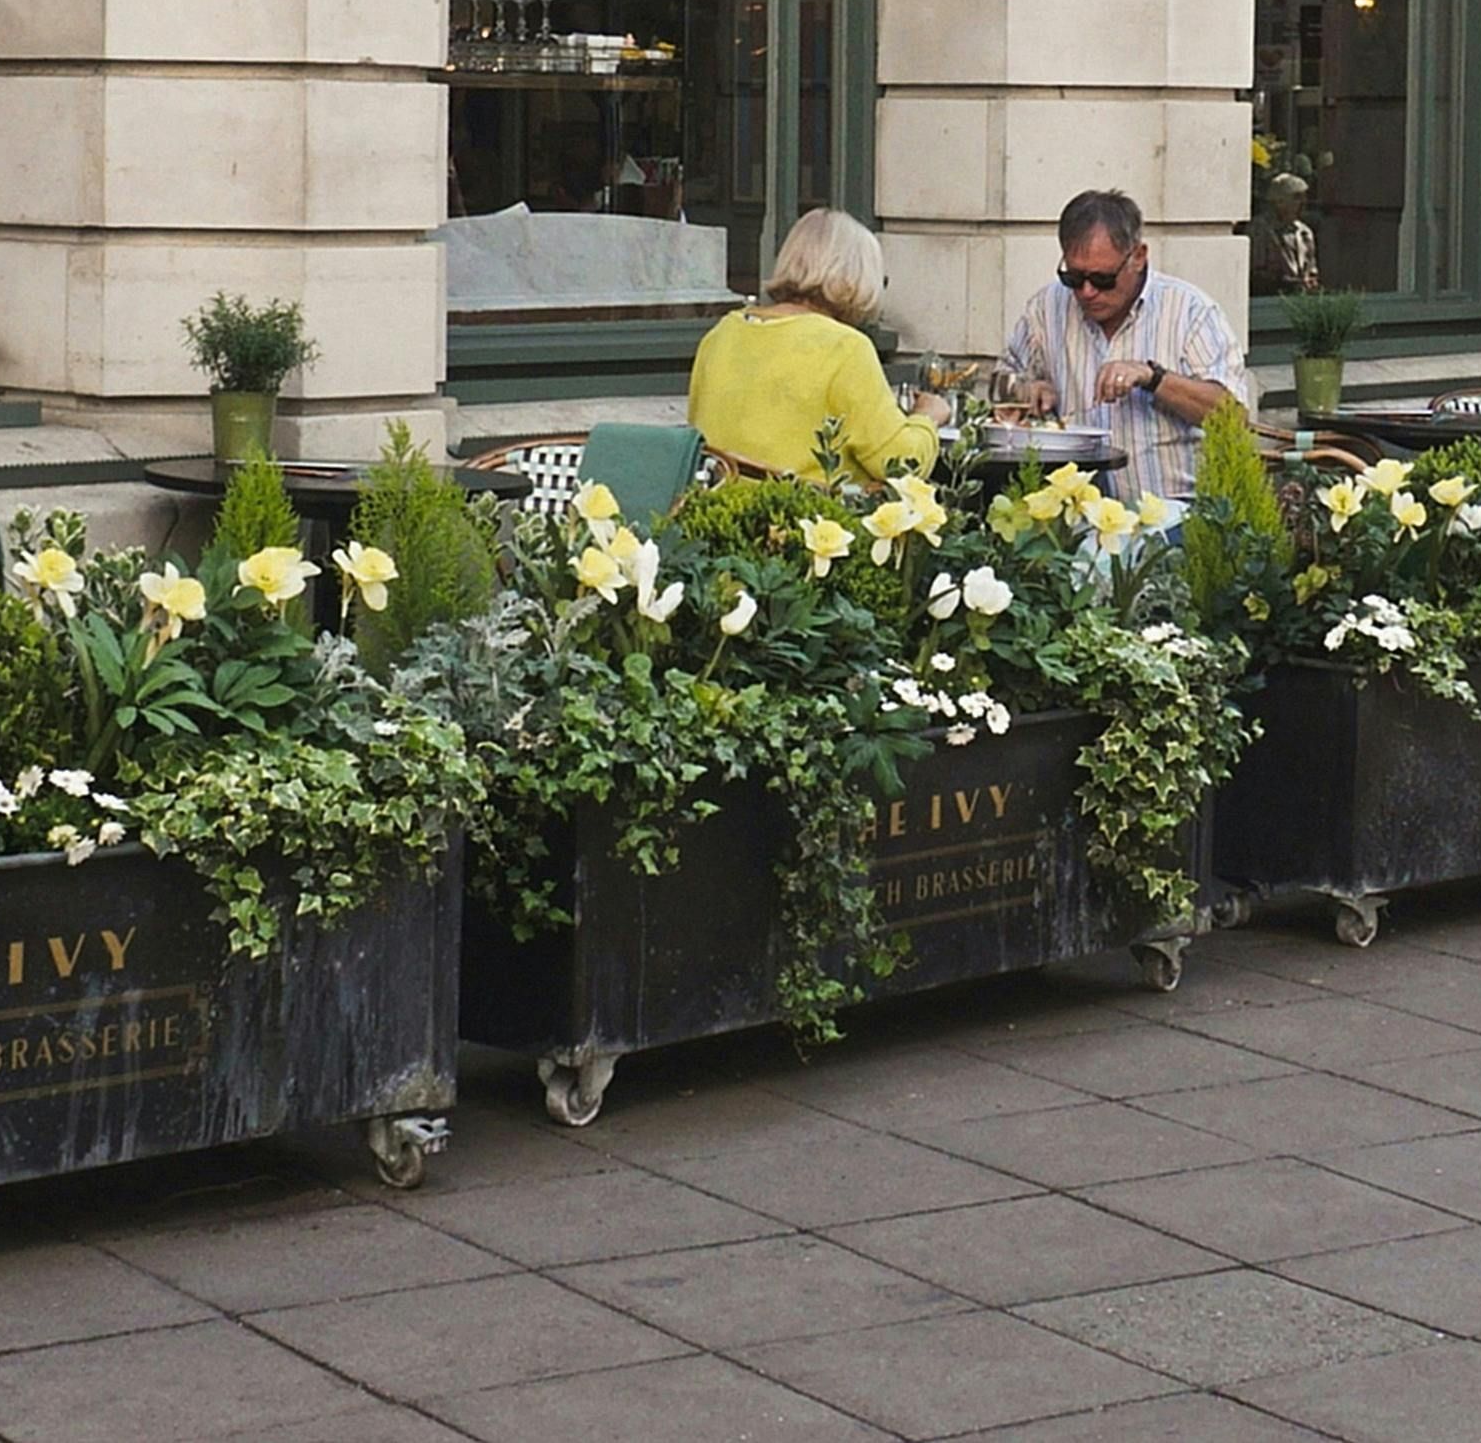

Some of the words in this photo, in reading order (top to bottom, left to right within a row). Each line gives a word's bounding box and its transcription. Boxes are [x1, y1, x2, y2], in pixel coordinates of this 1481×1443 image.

[930, 782, 1013, 831] IVY
[917, 854, 1038, 901] BRASSERIE
[7, 926, 137, 986] IVY
